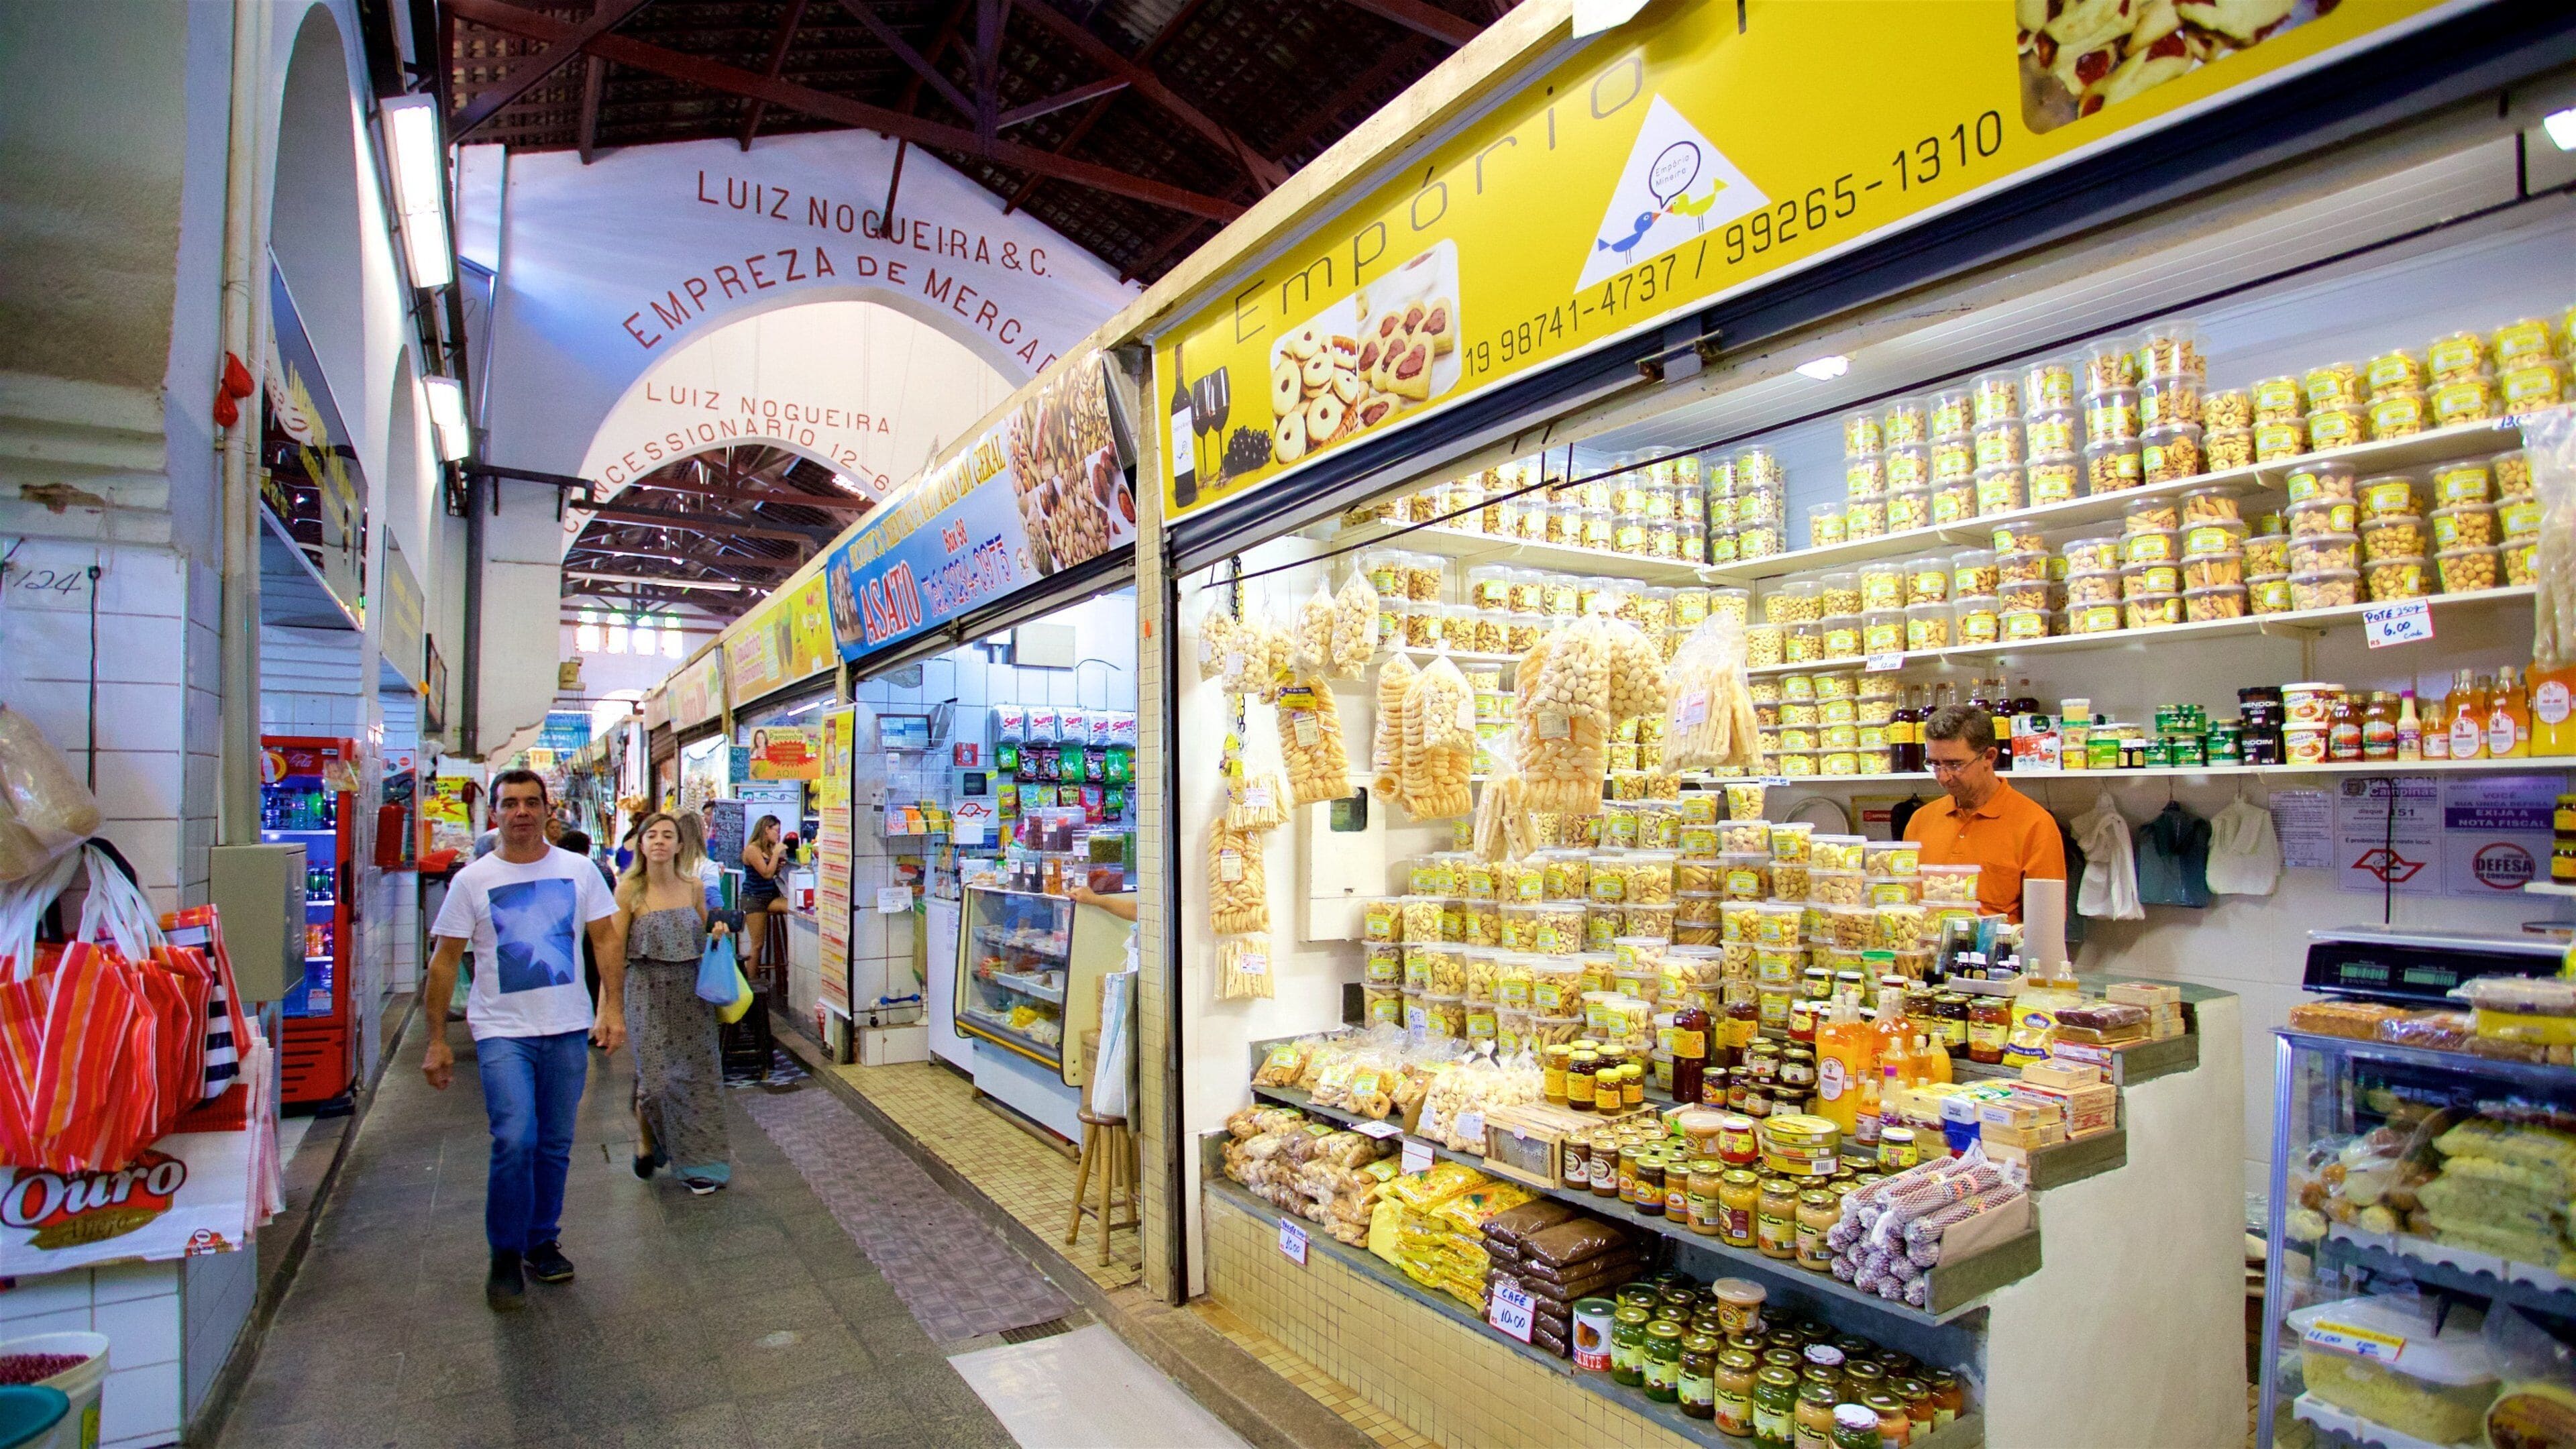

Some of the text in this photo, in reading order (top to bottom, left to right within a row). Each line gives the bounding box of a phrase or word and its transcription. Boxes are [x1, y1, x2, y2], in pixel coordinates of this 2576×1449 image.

[1656, 155, 1689, 177] Empório
[1656, 168, 1686, 186] Mineiro
[1234, 56, 1642, 343] Empório
[698, 170, 790, 220] LUIZ
[808, 197, 990, 264] NOGUEIRA
[1466, 110, 2002, 376] 19 98741-4737 / 99265-1310
[622, 246, 836, 349] EMPREZA
[857, 256, 907, 284] DE
[647, 382, 890, 434] LUIZ NOGUEIRA
[564, 418, 816, 534] CNCESSIONARIO
[957, 458, 975, 497] EM
[972, 434, 1007, 486] GERAL
[942, 527, 959, 554] Box
[13, 570, 82, 595] 124
[859, 559, 922, 646] ASATO
[2365, 609, 2392, 623] POTE
[2384, 621, 2410, 636] 6.00
[775, 769, 800, 777] AQUI
[2475, 809, 2529, 817] EXIJA A
[2475, 858, 2533, 872] DEFESA
[1, 1158, 187, 1228] Ouro
[1501, 1288, 1527, 1307] CAFÉ
[1501, 1308, 1525, 1328] 10.00
